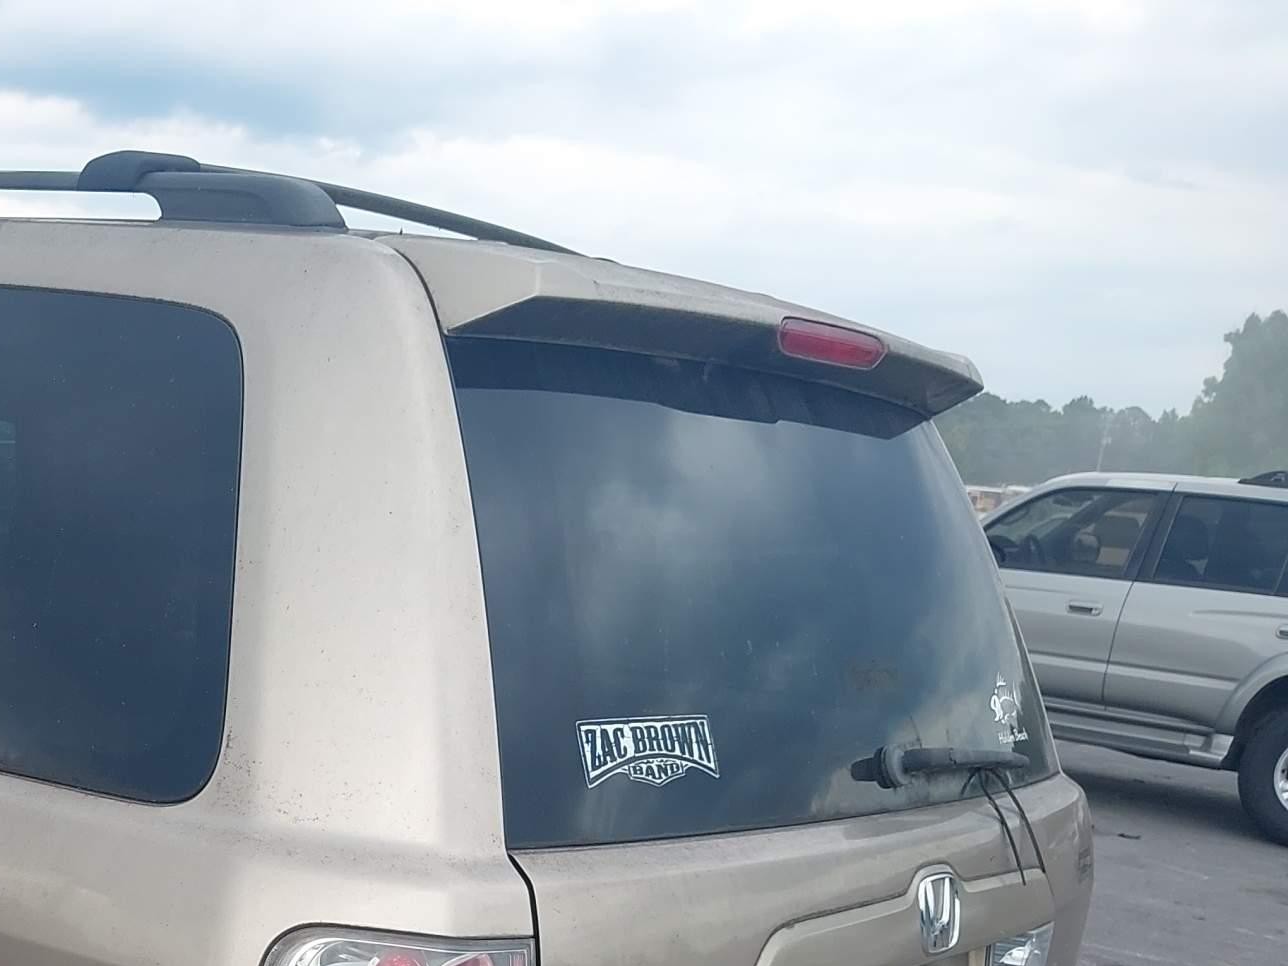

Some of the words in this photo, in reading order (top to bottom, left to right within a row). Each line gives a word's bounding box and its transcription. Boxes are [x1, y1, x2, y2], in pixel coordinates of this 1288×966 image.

[584, 727, 629, 769] ZAC
[631, 721, 712, 765] BROWN
[631, 762, 681, 779] BAND
